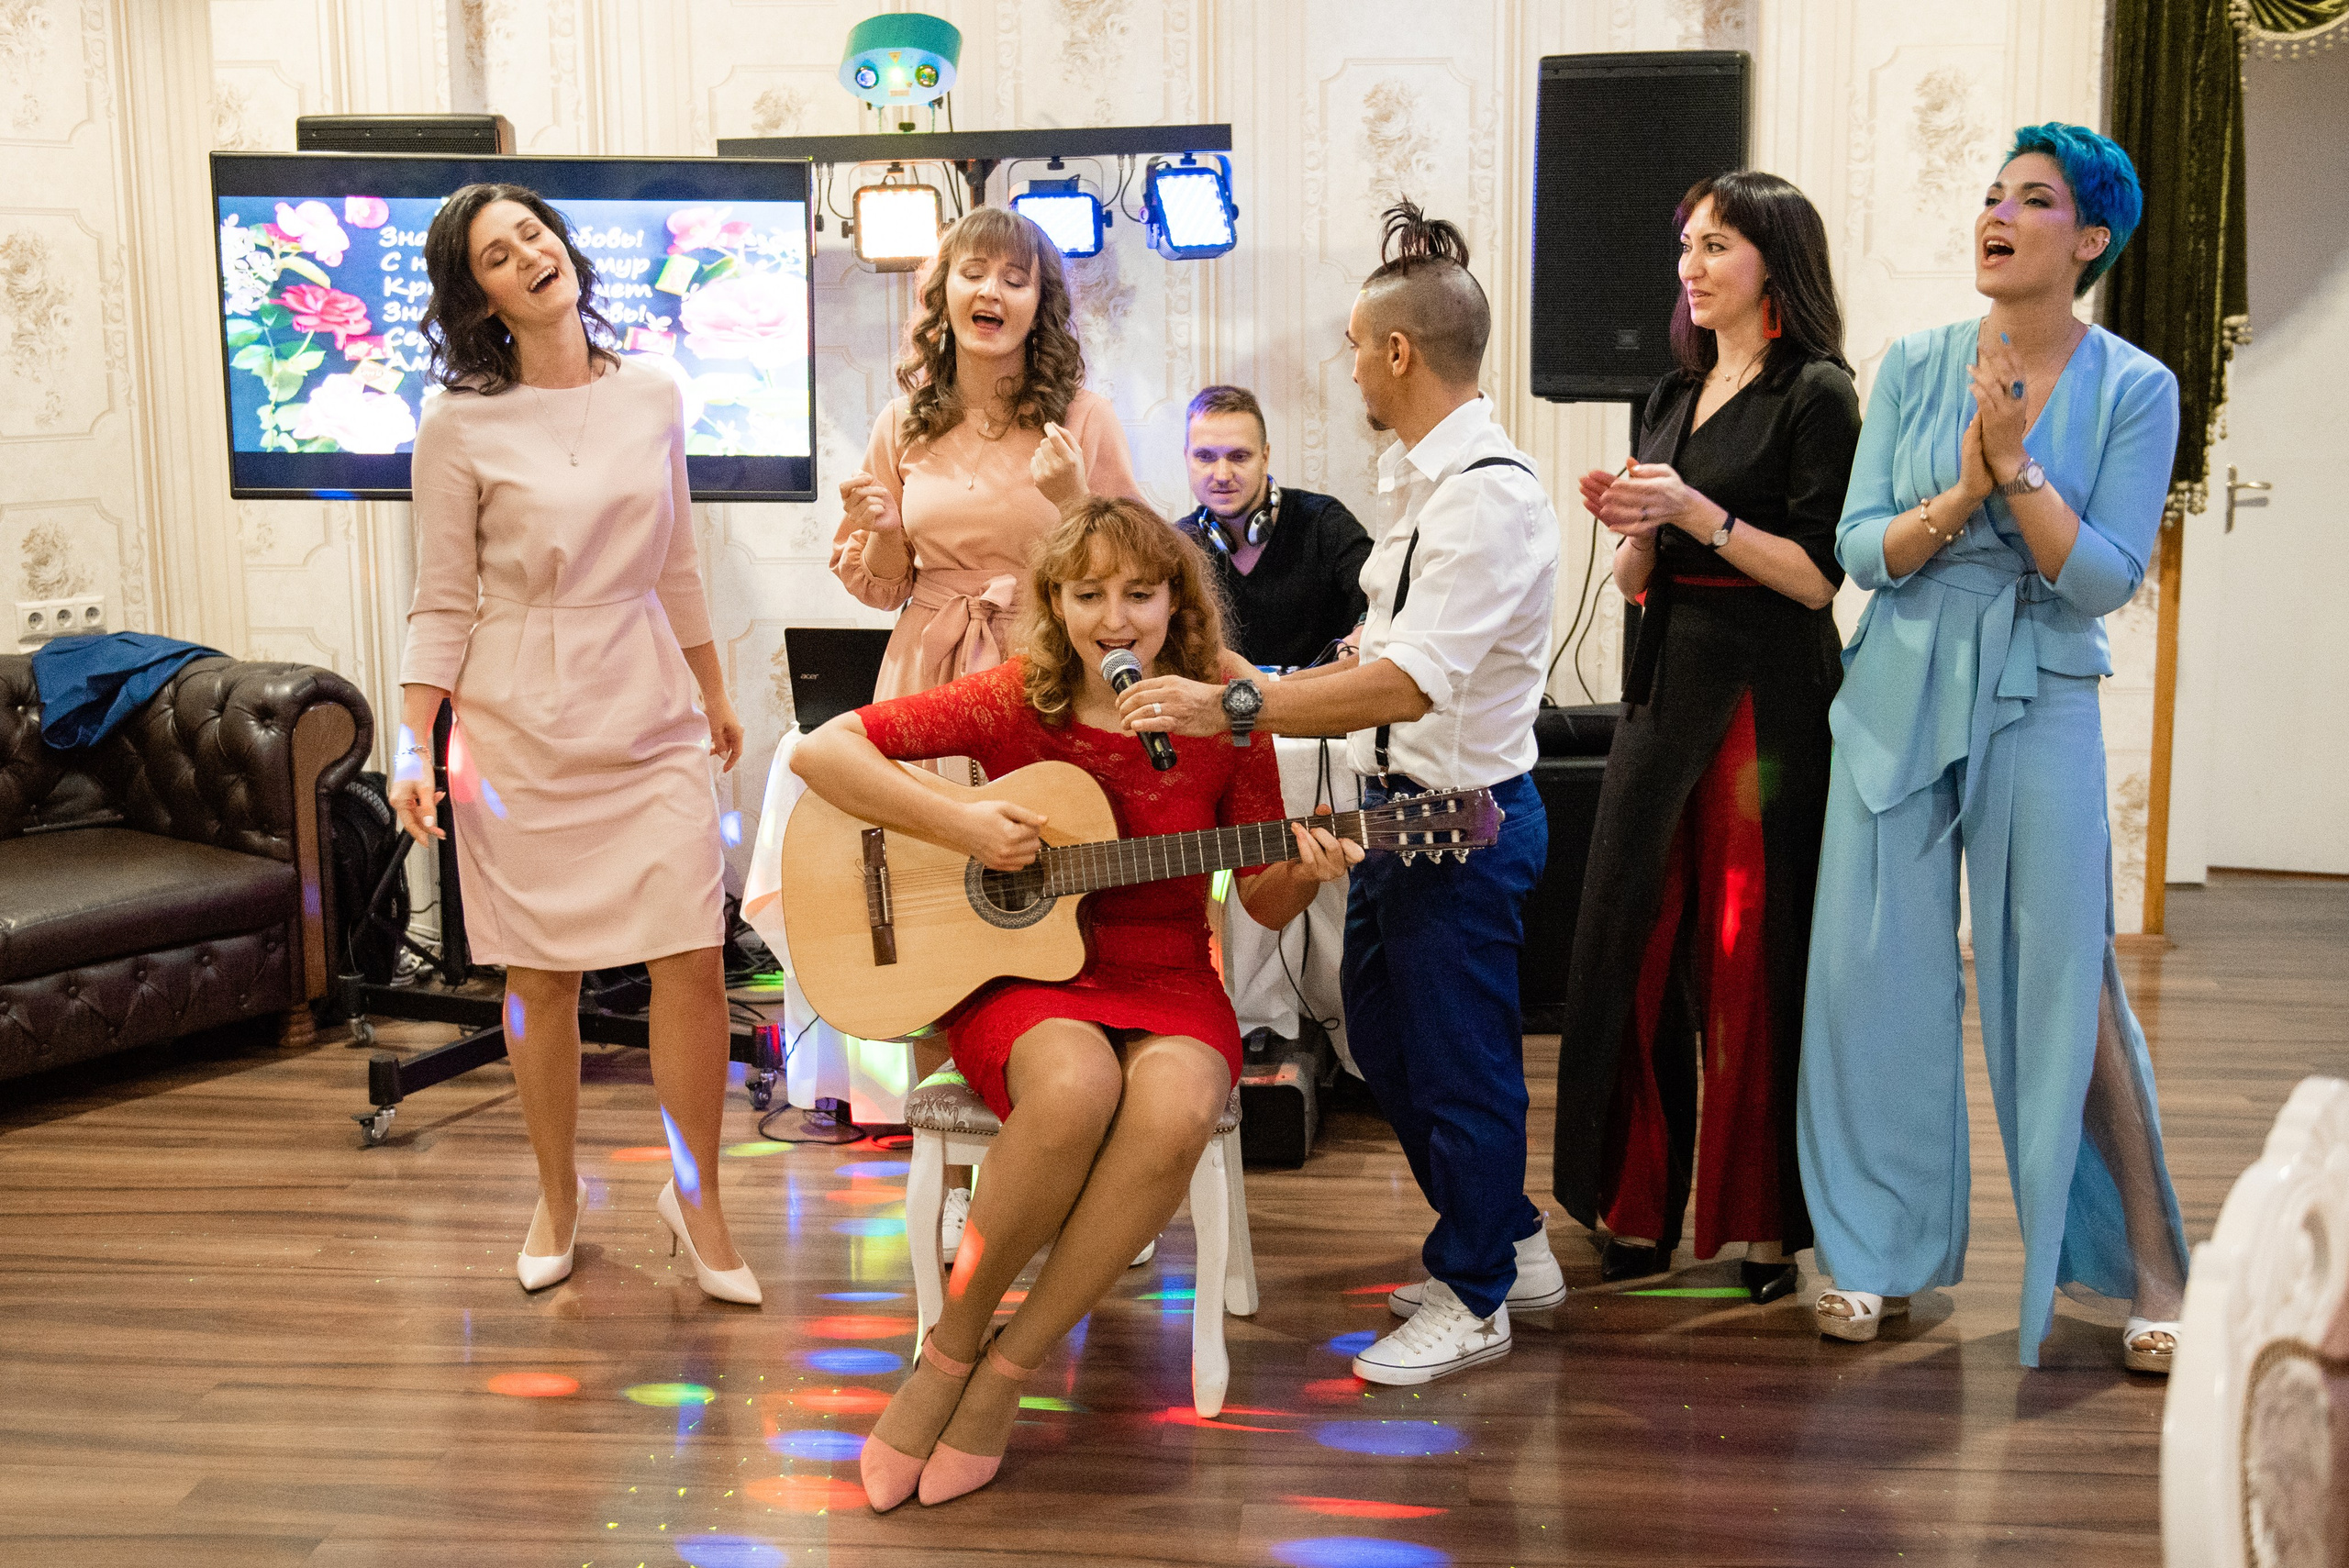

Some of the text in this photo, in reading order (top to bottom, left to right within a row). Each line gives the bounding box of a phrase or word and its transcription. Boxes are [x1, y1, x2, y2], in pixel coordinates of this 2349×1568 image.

[379, 226, 429, 248] Зна
[380, 250, 402, 272] С
[595, 257, 651, 281] мур
[384, 326, 431, 354] Сер
